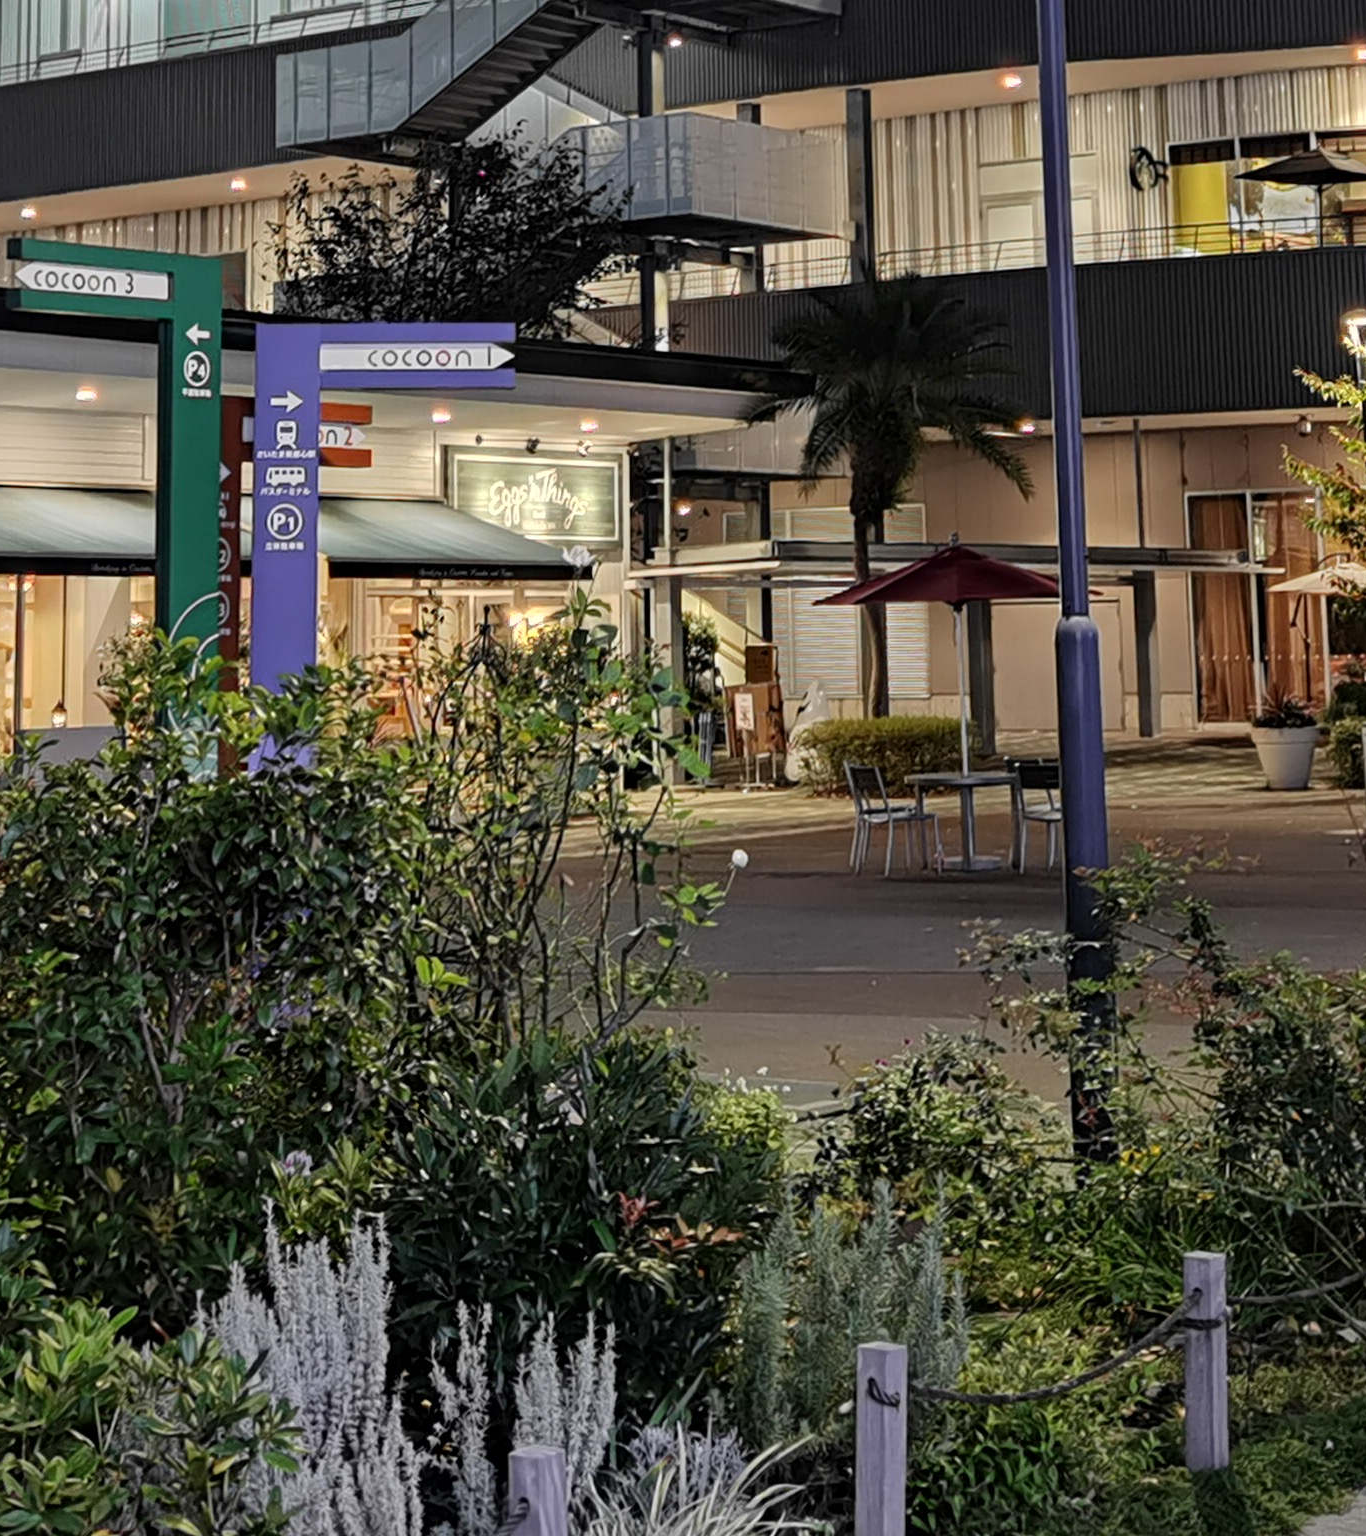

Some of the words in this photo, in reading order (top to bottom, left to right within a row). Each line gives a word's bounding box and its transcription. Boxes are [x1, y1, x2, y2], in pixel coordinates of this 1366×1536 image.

[34, 269, 117, 293] cocoon
[124, 272, 134, 294] 3
[367, 349, 472, 367] cocoon
[343, 425, 354, 447] 2
[488, 480, 528, 527] Eggs
[536, 467, 588, 530] Things
